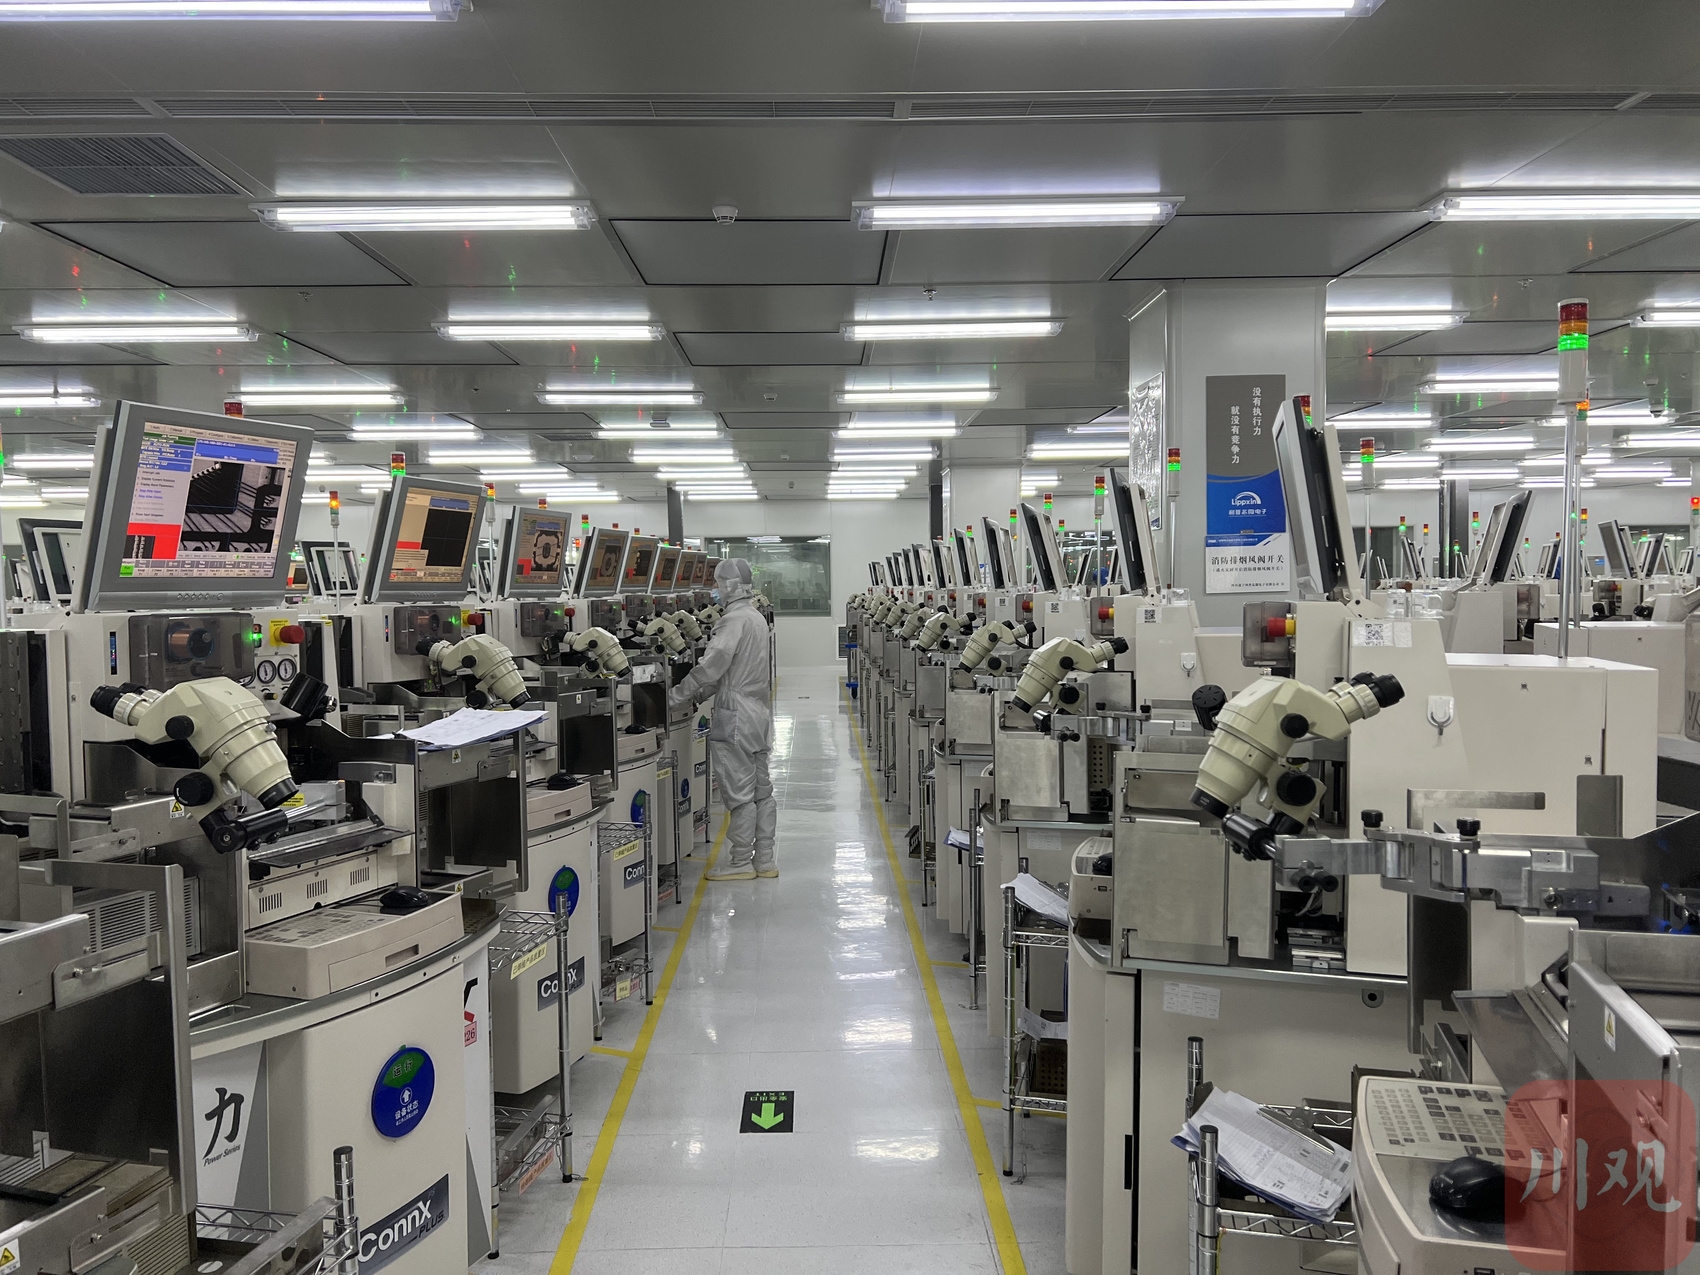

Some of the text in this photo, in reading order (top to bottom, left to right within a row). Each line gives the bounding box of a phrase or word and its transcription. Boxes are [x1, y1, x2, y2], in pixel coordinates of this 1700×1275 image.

[1252, 387, 1262, 436] 没有执行力
[1230, 405, 1240, 464] 就没有竞争力
[1231, 498, 1256, 506] Lippxin
[1211, 554, 1284, 565] 消防排烟风阀开关
[541, 968, 577, 998] ConX
[202, 1087, 244, 1160] 力
[395, 1100, 419, 1119] 设备状态
[203, 1144, 241, 1167] Power Series
[418, 1209, 445, 1238] PLUS
